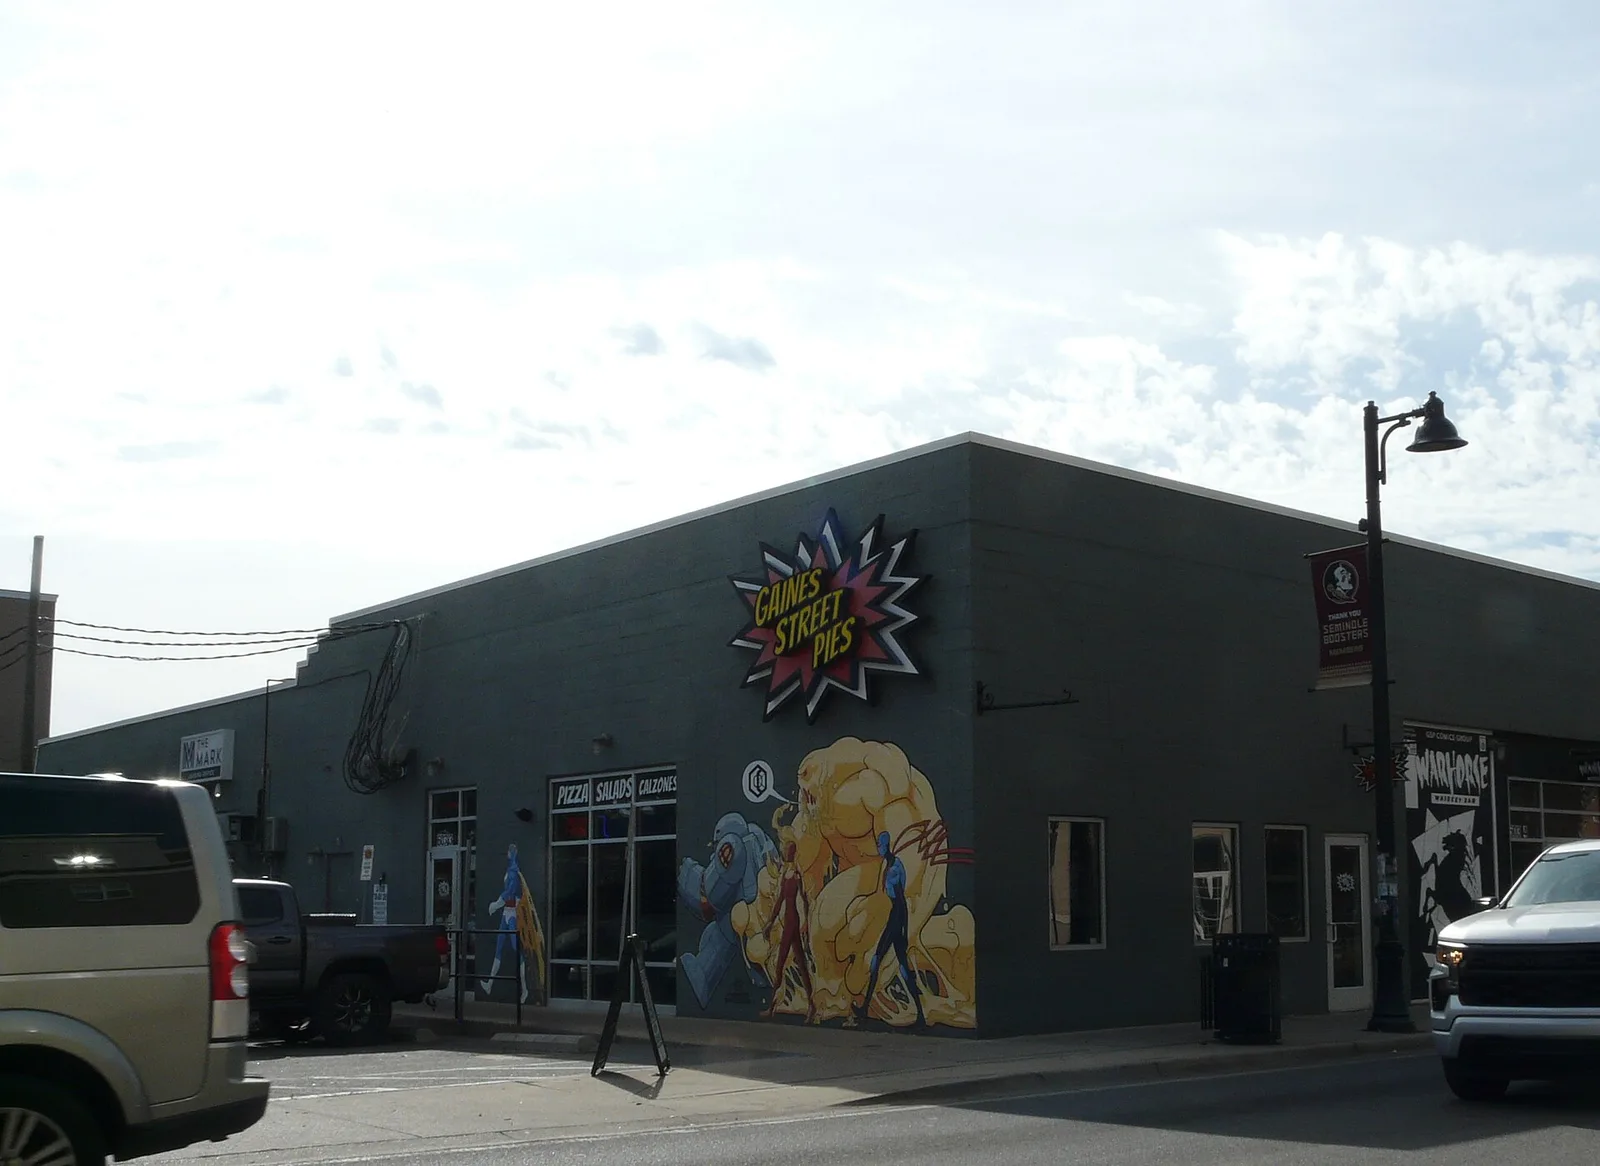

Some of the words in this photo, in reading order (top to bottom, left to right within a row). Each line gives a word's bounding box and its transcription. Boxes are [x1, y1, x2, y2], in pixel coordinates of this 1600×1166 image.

[755, 568, 823, 627] GAINES
[775, 590, 843, 655] STREET
[1323, 618, 1368, 635] SEMINOLE
[1328, 611, 1348, 621] THANK
[1349, 609, 1361, 618] YOU
[813, 617, 855, 668] PIES
[1323, 628, 1369, 645] BOOSTERS
[196, 748, 221, 767] MARK
[1416, 748, 1489, 796] WARHORSE
[557, 783, 589, 805] PIZZA
[596, 778, 632, 802] SALADS
[639, 776, 677, 795] CALZONES
